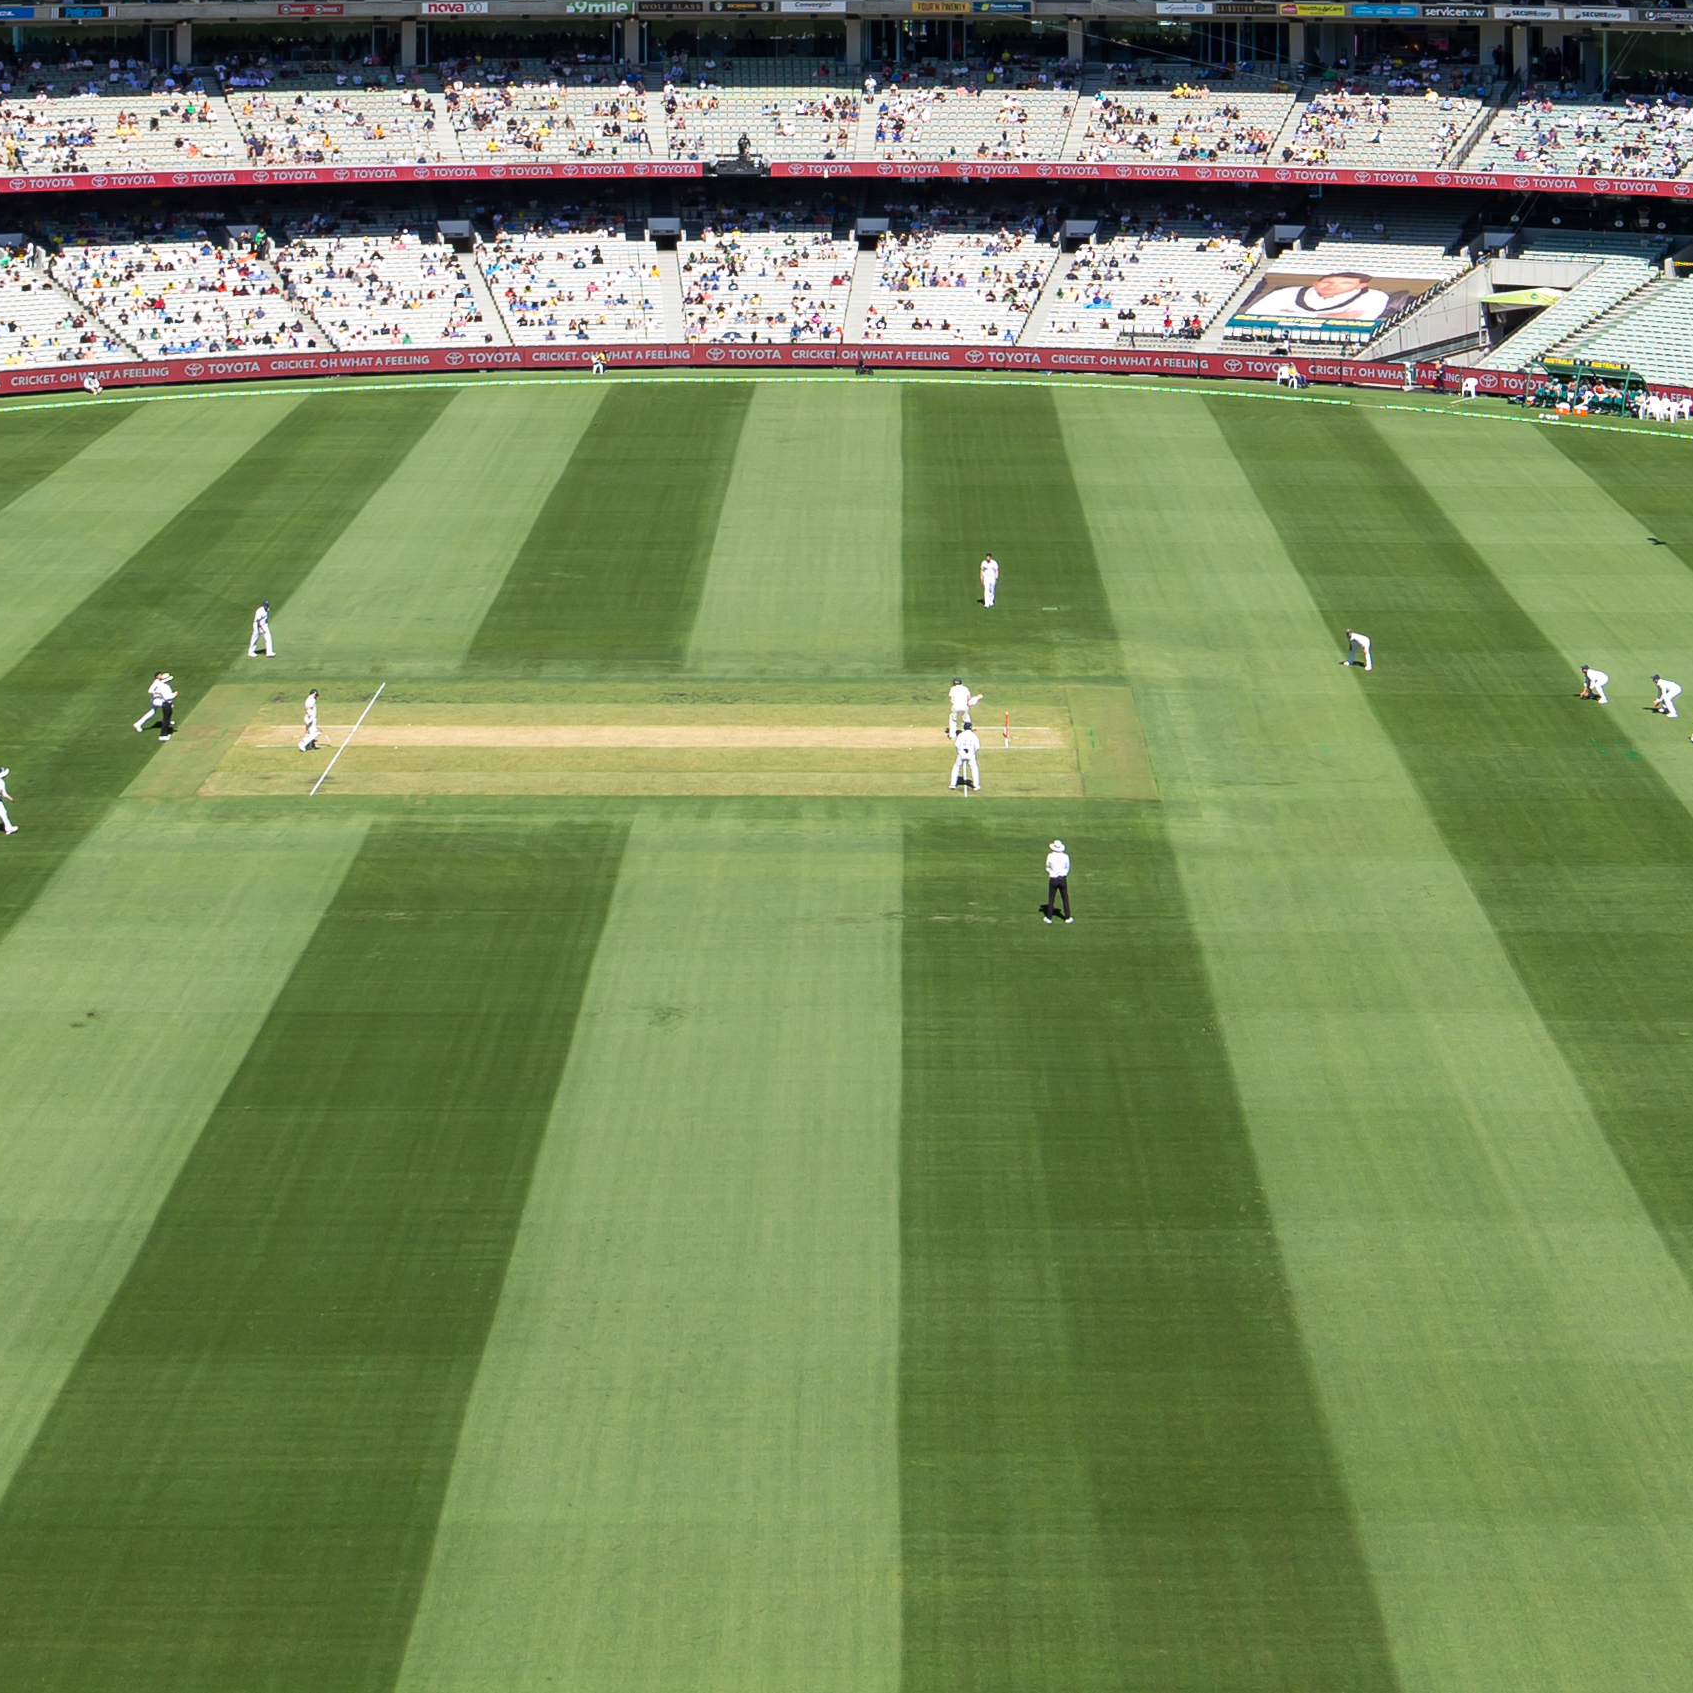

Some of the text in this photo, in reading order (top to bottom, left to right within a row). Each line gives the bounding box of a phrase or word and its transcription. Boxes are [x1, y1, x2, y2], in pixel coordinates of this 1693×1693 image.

[1425, 7, 1484, 17] servicenow
[897, 165, 940, 174] TOYOTA
[354, 170, 397, 180] TOYOTA
[1374, 172, 1418, 183] TOYOTA
[729, 350, 781, 359] TOYOTA
[271, 355, 429, 370] CRICKET. OH WHAT A FEELING
[1051, 355, 1208, 368] CRICKET. OH WHAT A FEELING
[1544, 357, 1574, 365] AUSTRALIA
[1591, 362, 1621, 370] AUSTRALIA
[208, 362, 260, 373] TOYOTA
